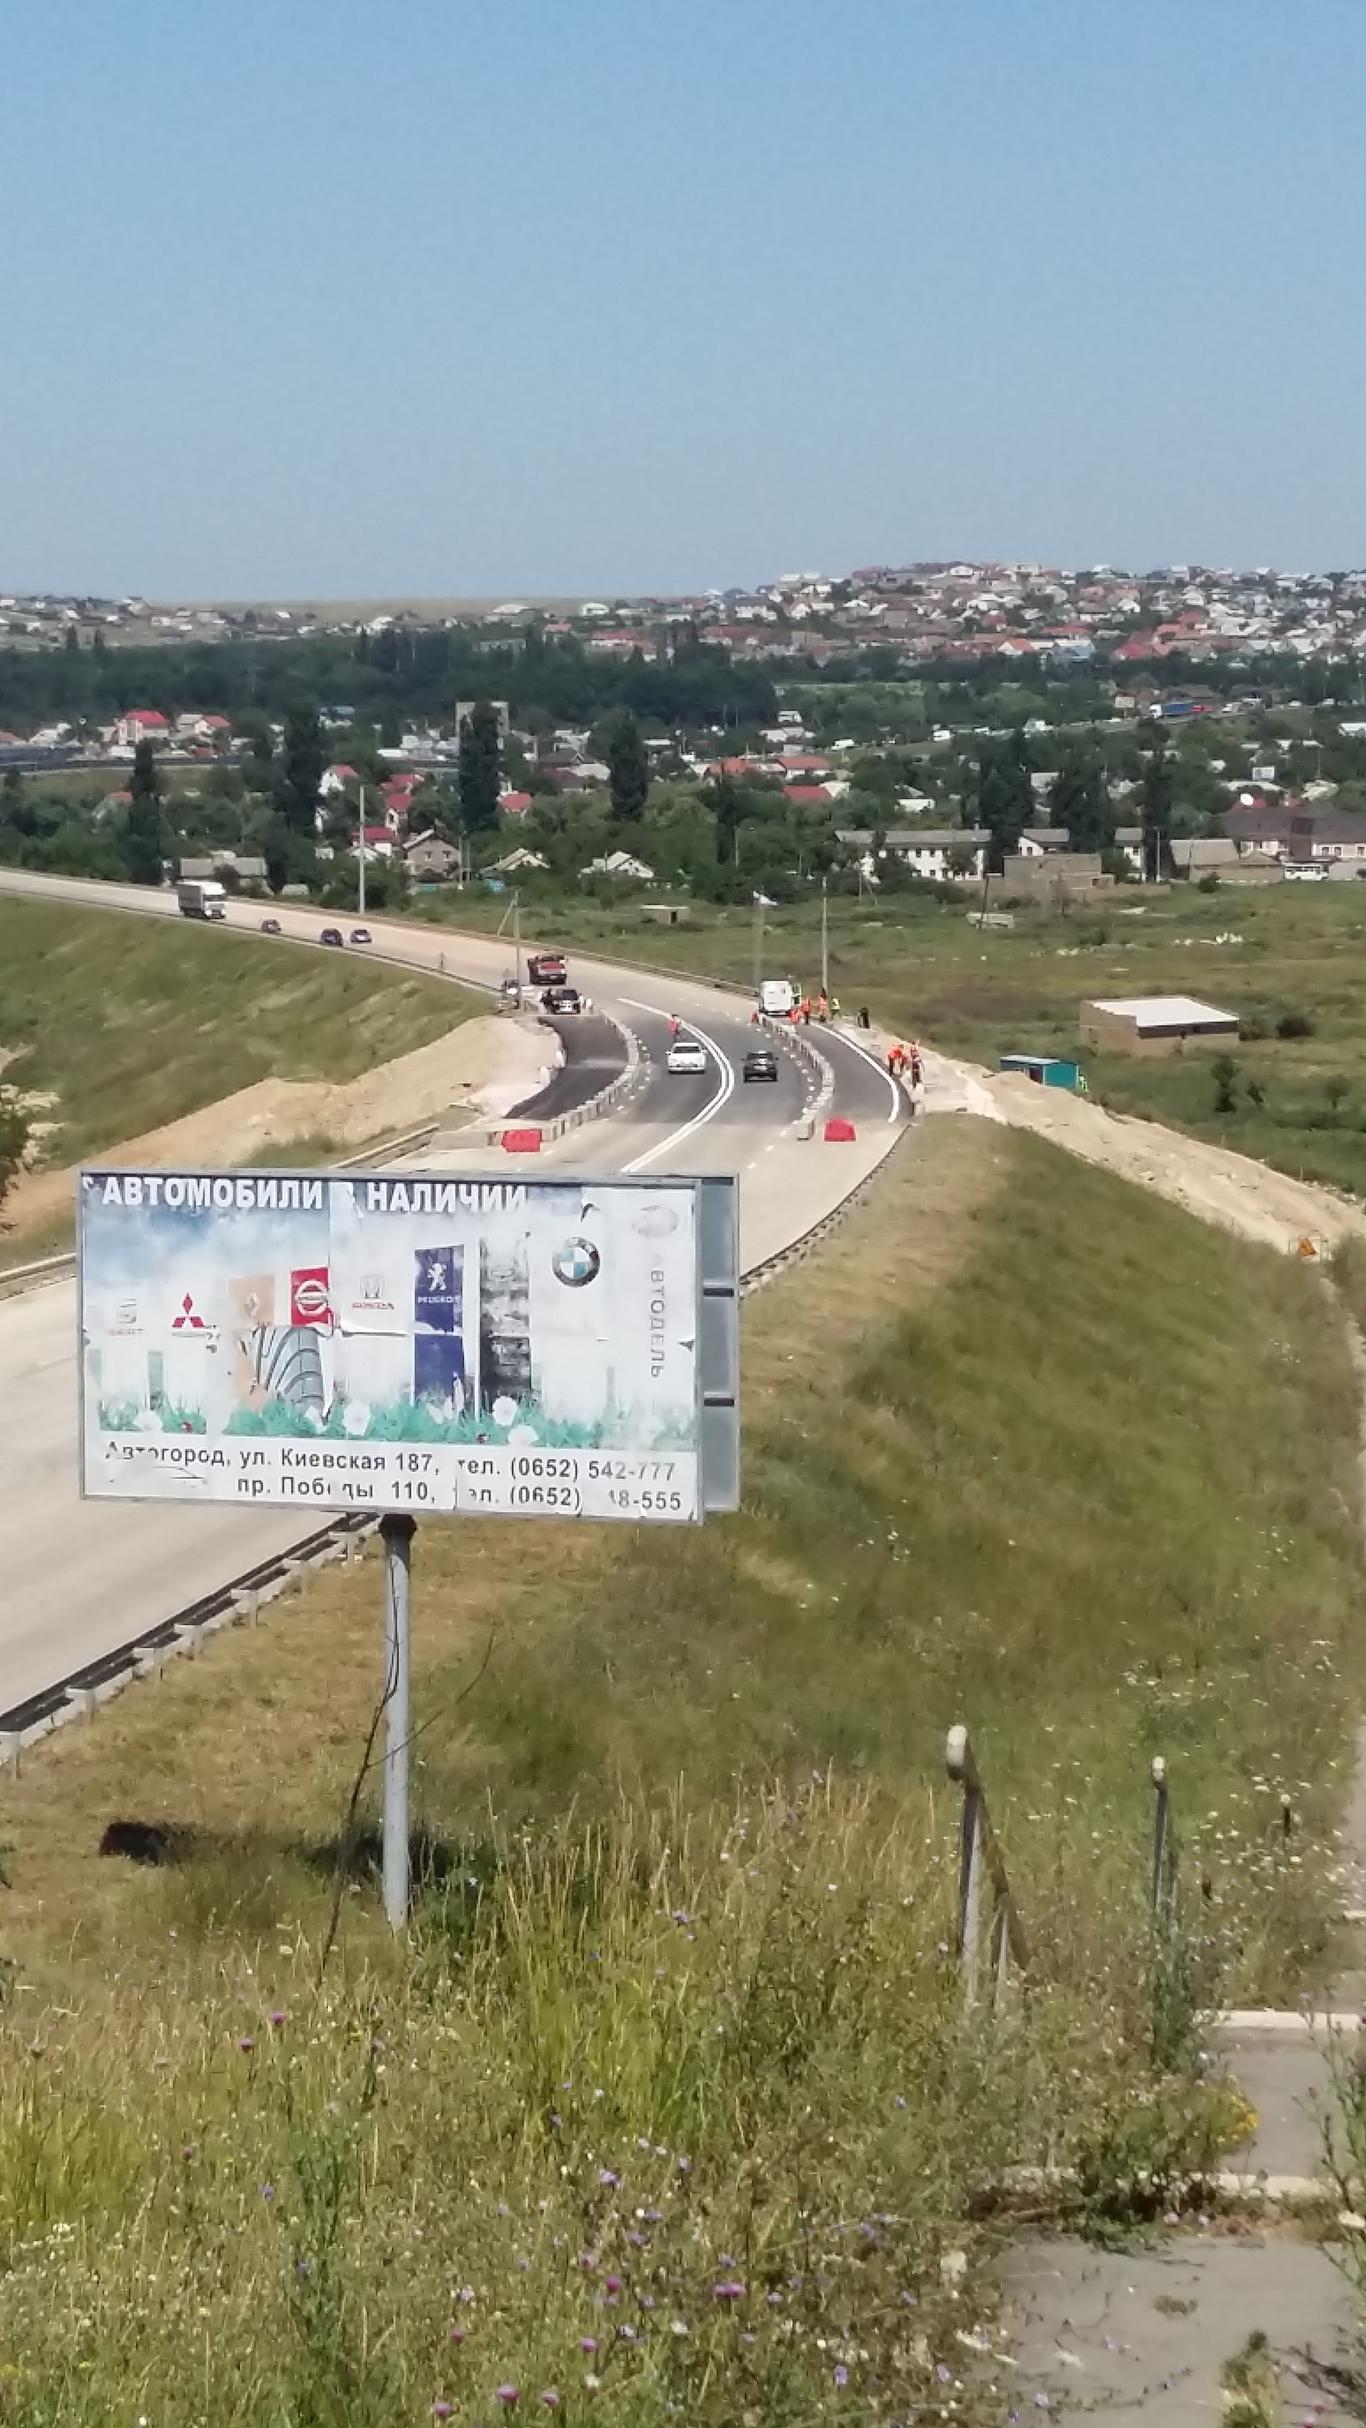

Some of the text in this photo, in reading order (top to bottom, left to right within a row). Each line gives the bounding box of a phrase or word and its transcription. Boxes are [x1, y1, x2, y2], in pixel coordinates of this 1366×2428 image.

[102, 1176, 323, 1210] АВТОМОБИЛИ
[366, 1181, 527, 1213] НАЛИЧИИ
[650, 1267, 665, 1378] ВТОДЕЛЬ
[239, 1451, 271, 1469] ул.
[281, 1448, 386, 1470] Киевская
[395, 1453, 439, 1477] 187,
[511, 1457, 578, 1483] (0652)
[588, 1460, 675, 1481] 542-777
[237, 1478, 270, 1497] пр.
[282, 1476, 373, 1500] Побды
[391, 1480, 435, 1503] 110,
